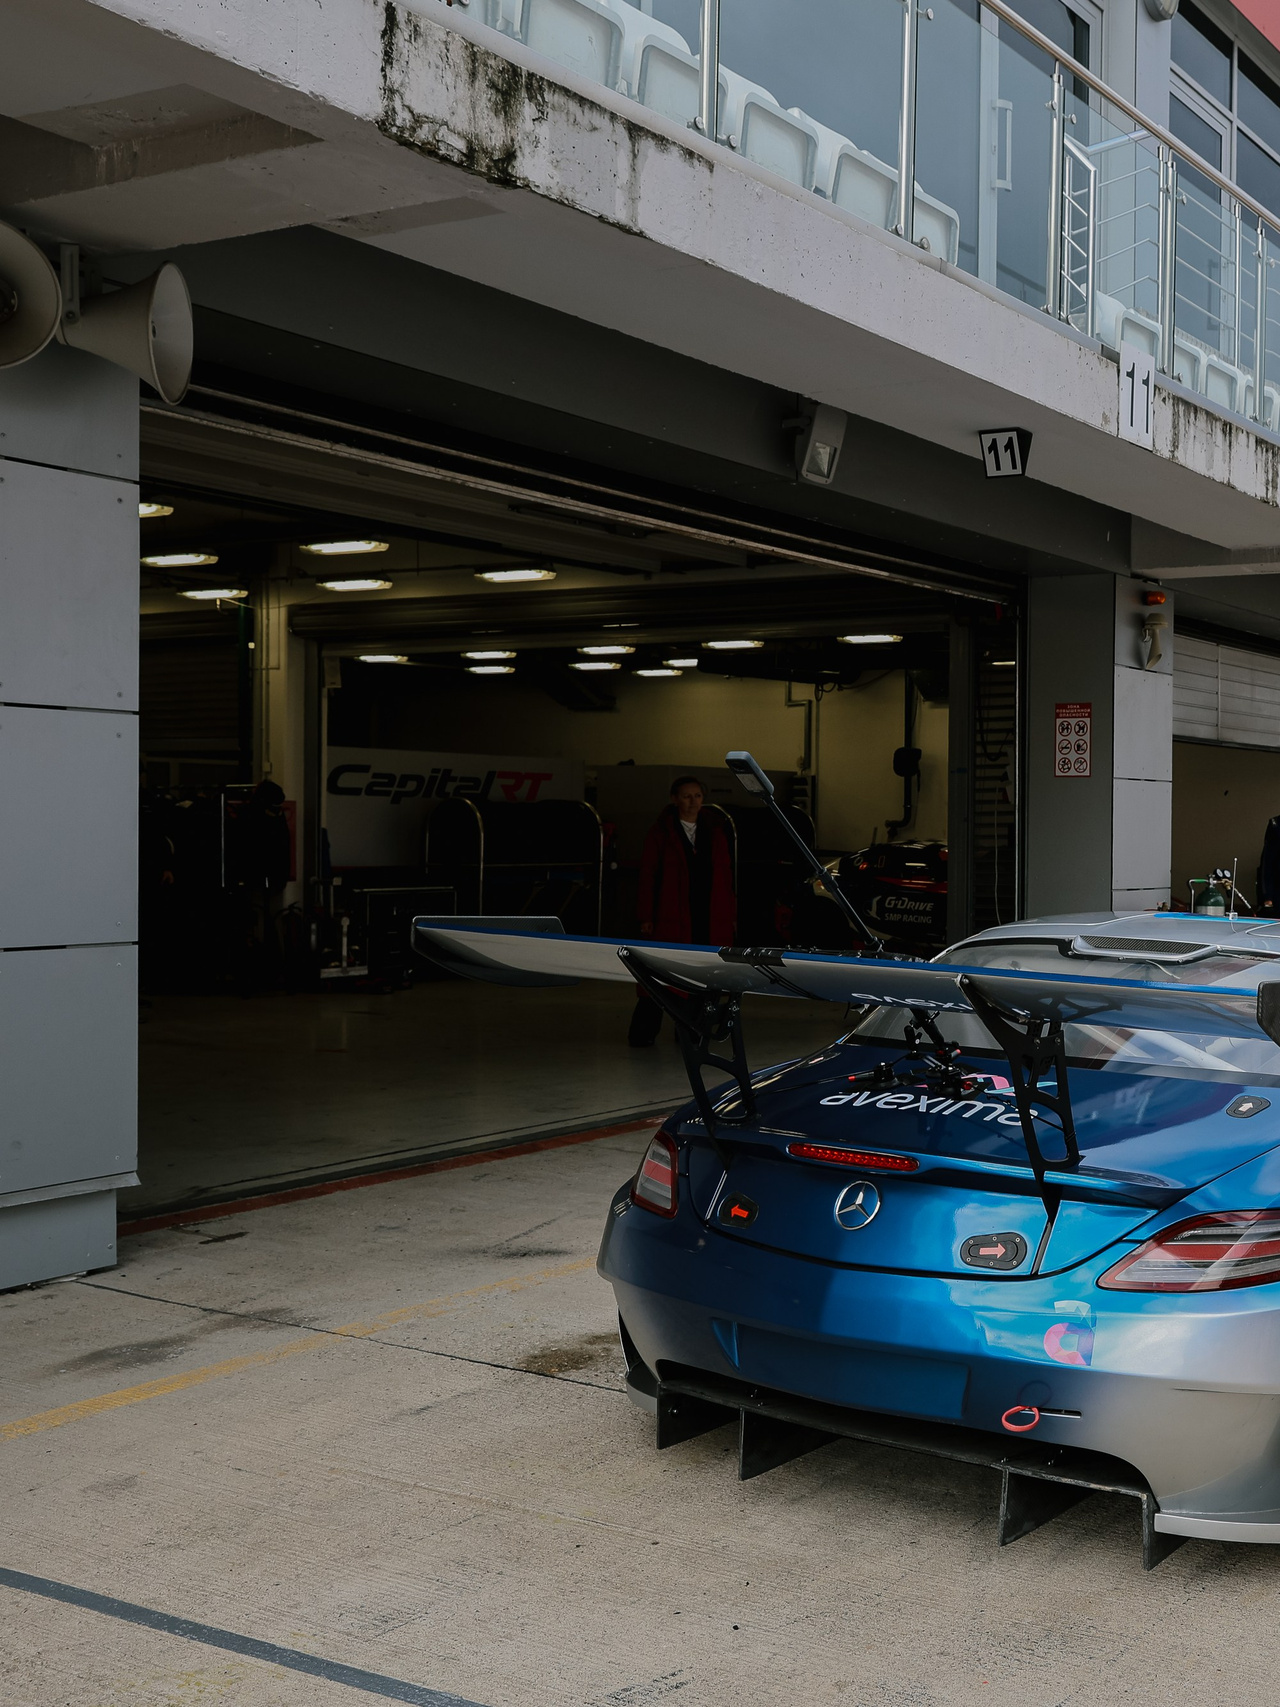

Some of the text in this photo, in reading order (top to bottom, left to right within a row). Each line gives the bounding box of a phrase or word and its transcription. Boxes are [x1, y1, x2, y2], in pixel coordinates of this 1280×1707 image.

[1126, 362, 1150, 434] 11
[987, 436, 1018, 471] 11
[884, 913, 933, 924] SMP RACING
[820, 1090, 1038, 1126] avexima
